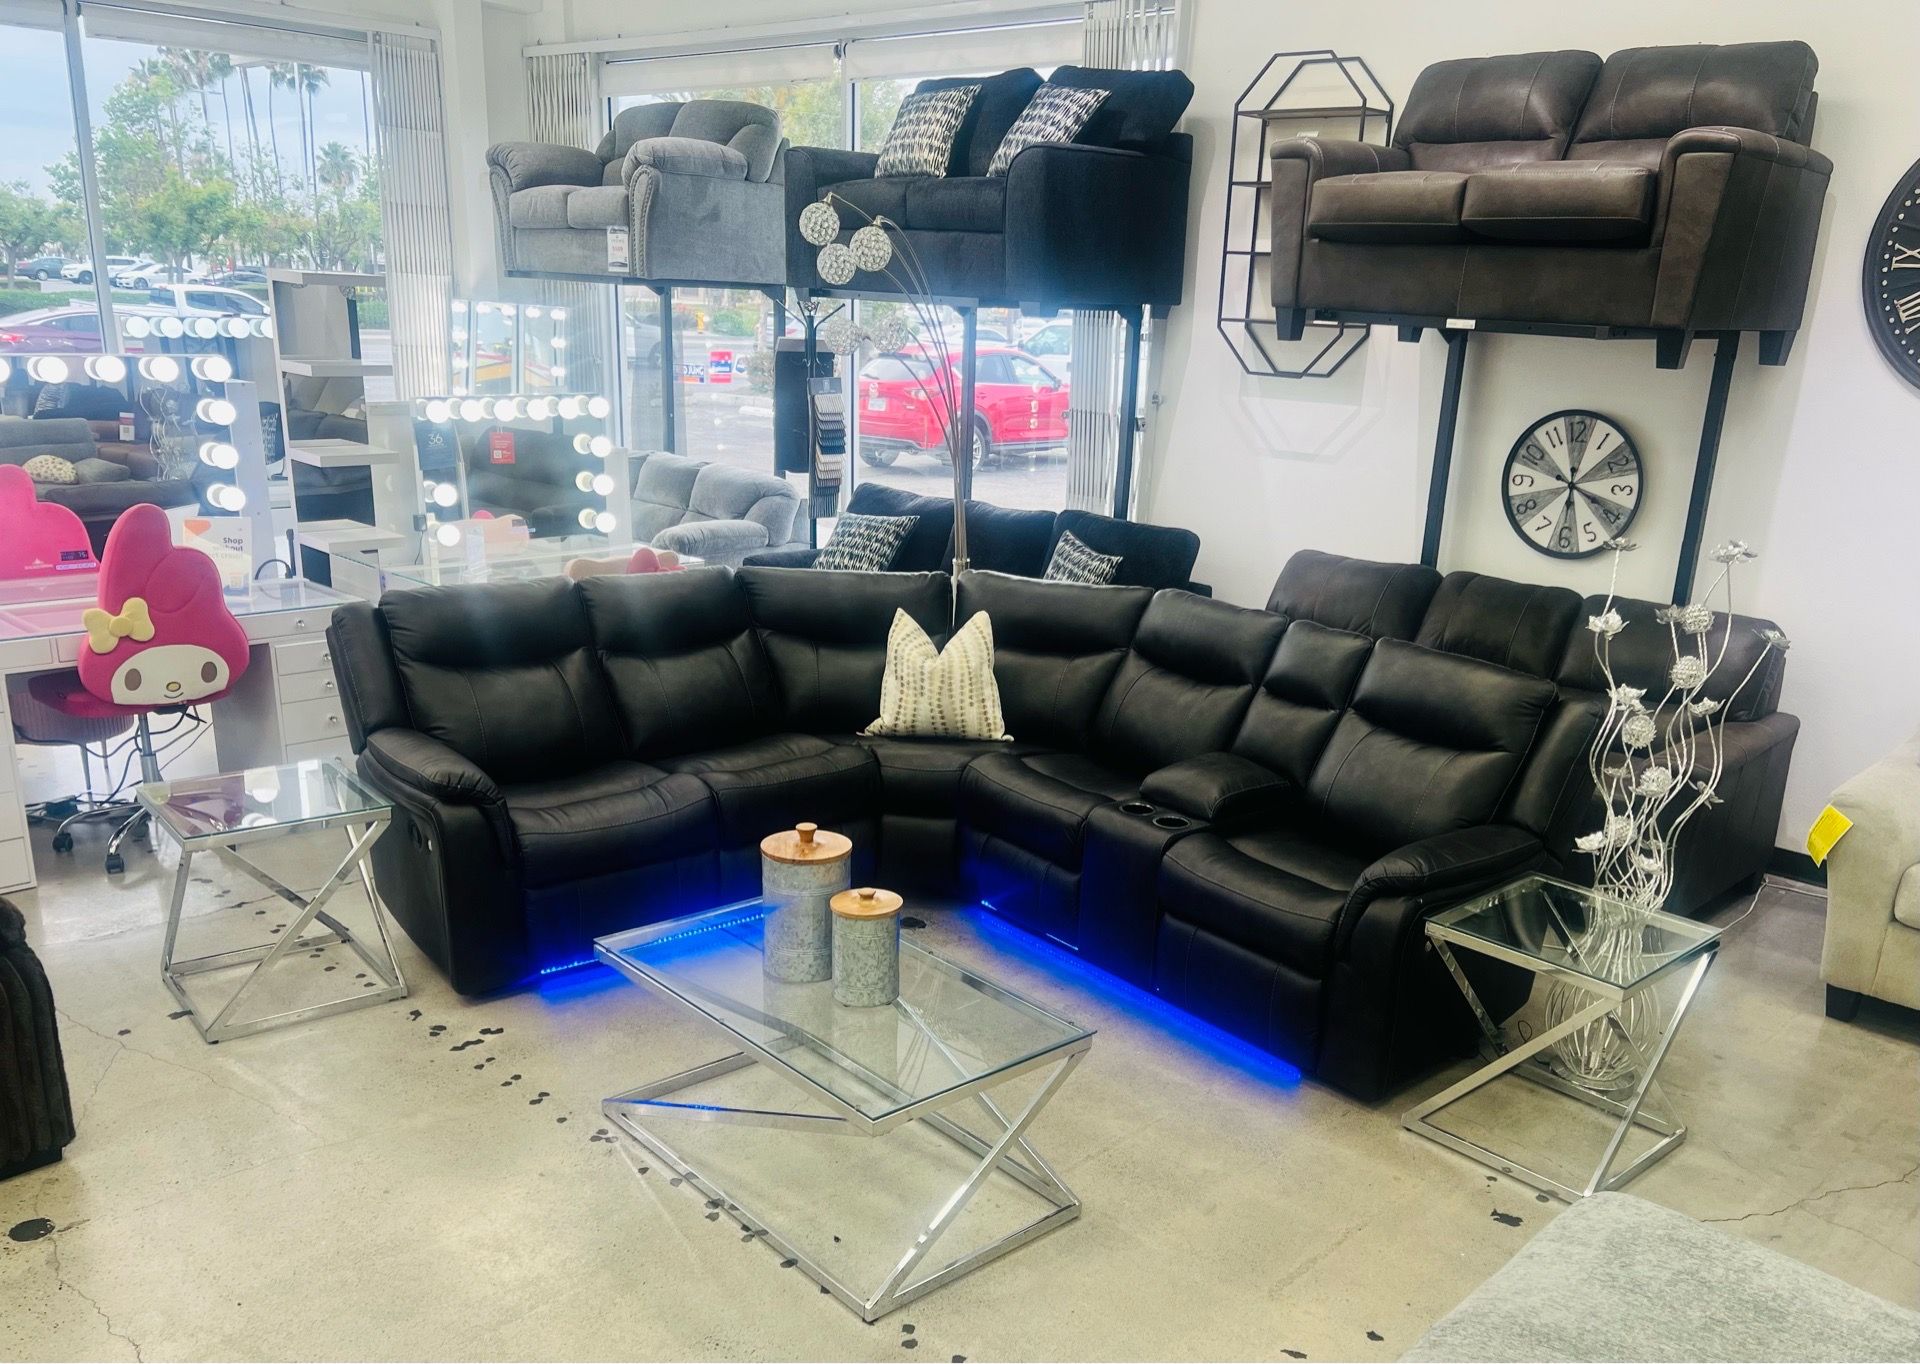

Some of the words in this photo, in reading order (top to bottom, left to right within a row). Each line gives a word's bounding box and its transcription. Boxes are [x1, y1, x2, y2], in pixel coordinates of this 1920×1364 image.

[428, 433, 443, 445] 36
[1545, 426, 1563, 448] 11
[1569, 420, 1587, 443] 12
[1596, 432, 1610, 450] 1
[1521, 443, 1545, 466] 10
[1607, 455, 1629, 473] 2
[1512, 474, 1534, 487] 9
[1610, 484, 1633, 496] 3
[1516, 499, 1537, 515] 8
[1535, 515, 1552, 532] 7
[1602, 508, 1623, 525] 4
[1558, 526, 1571, 549] 6
[1583, 521, 1597, 543] 5
[223, 537, 244, 546] Shop
